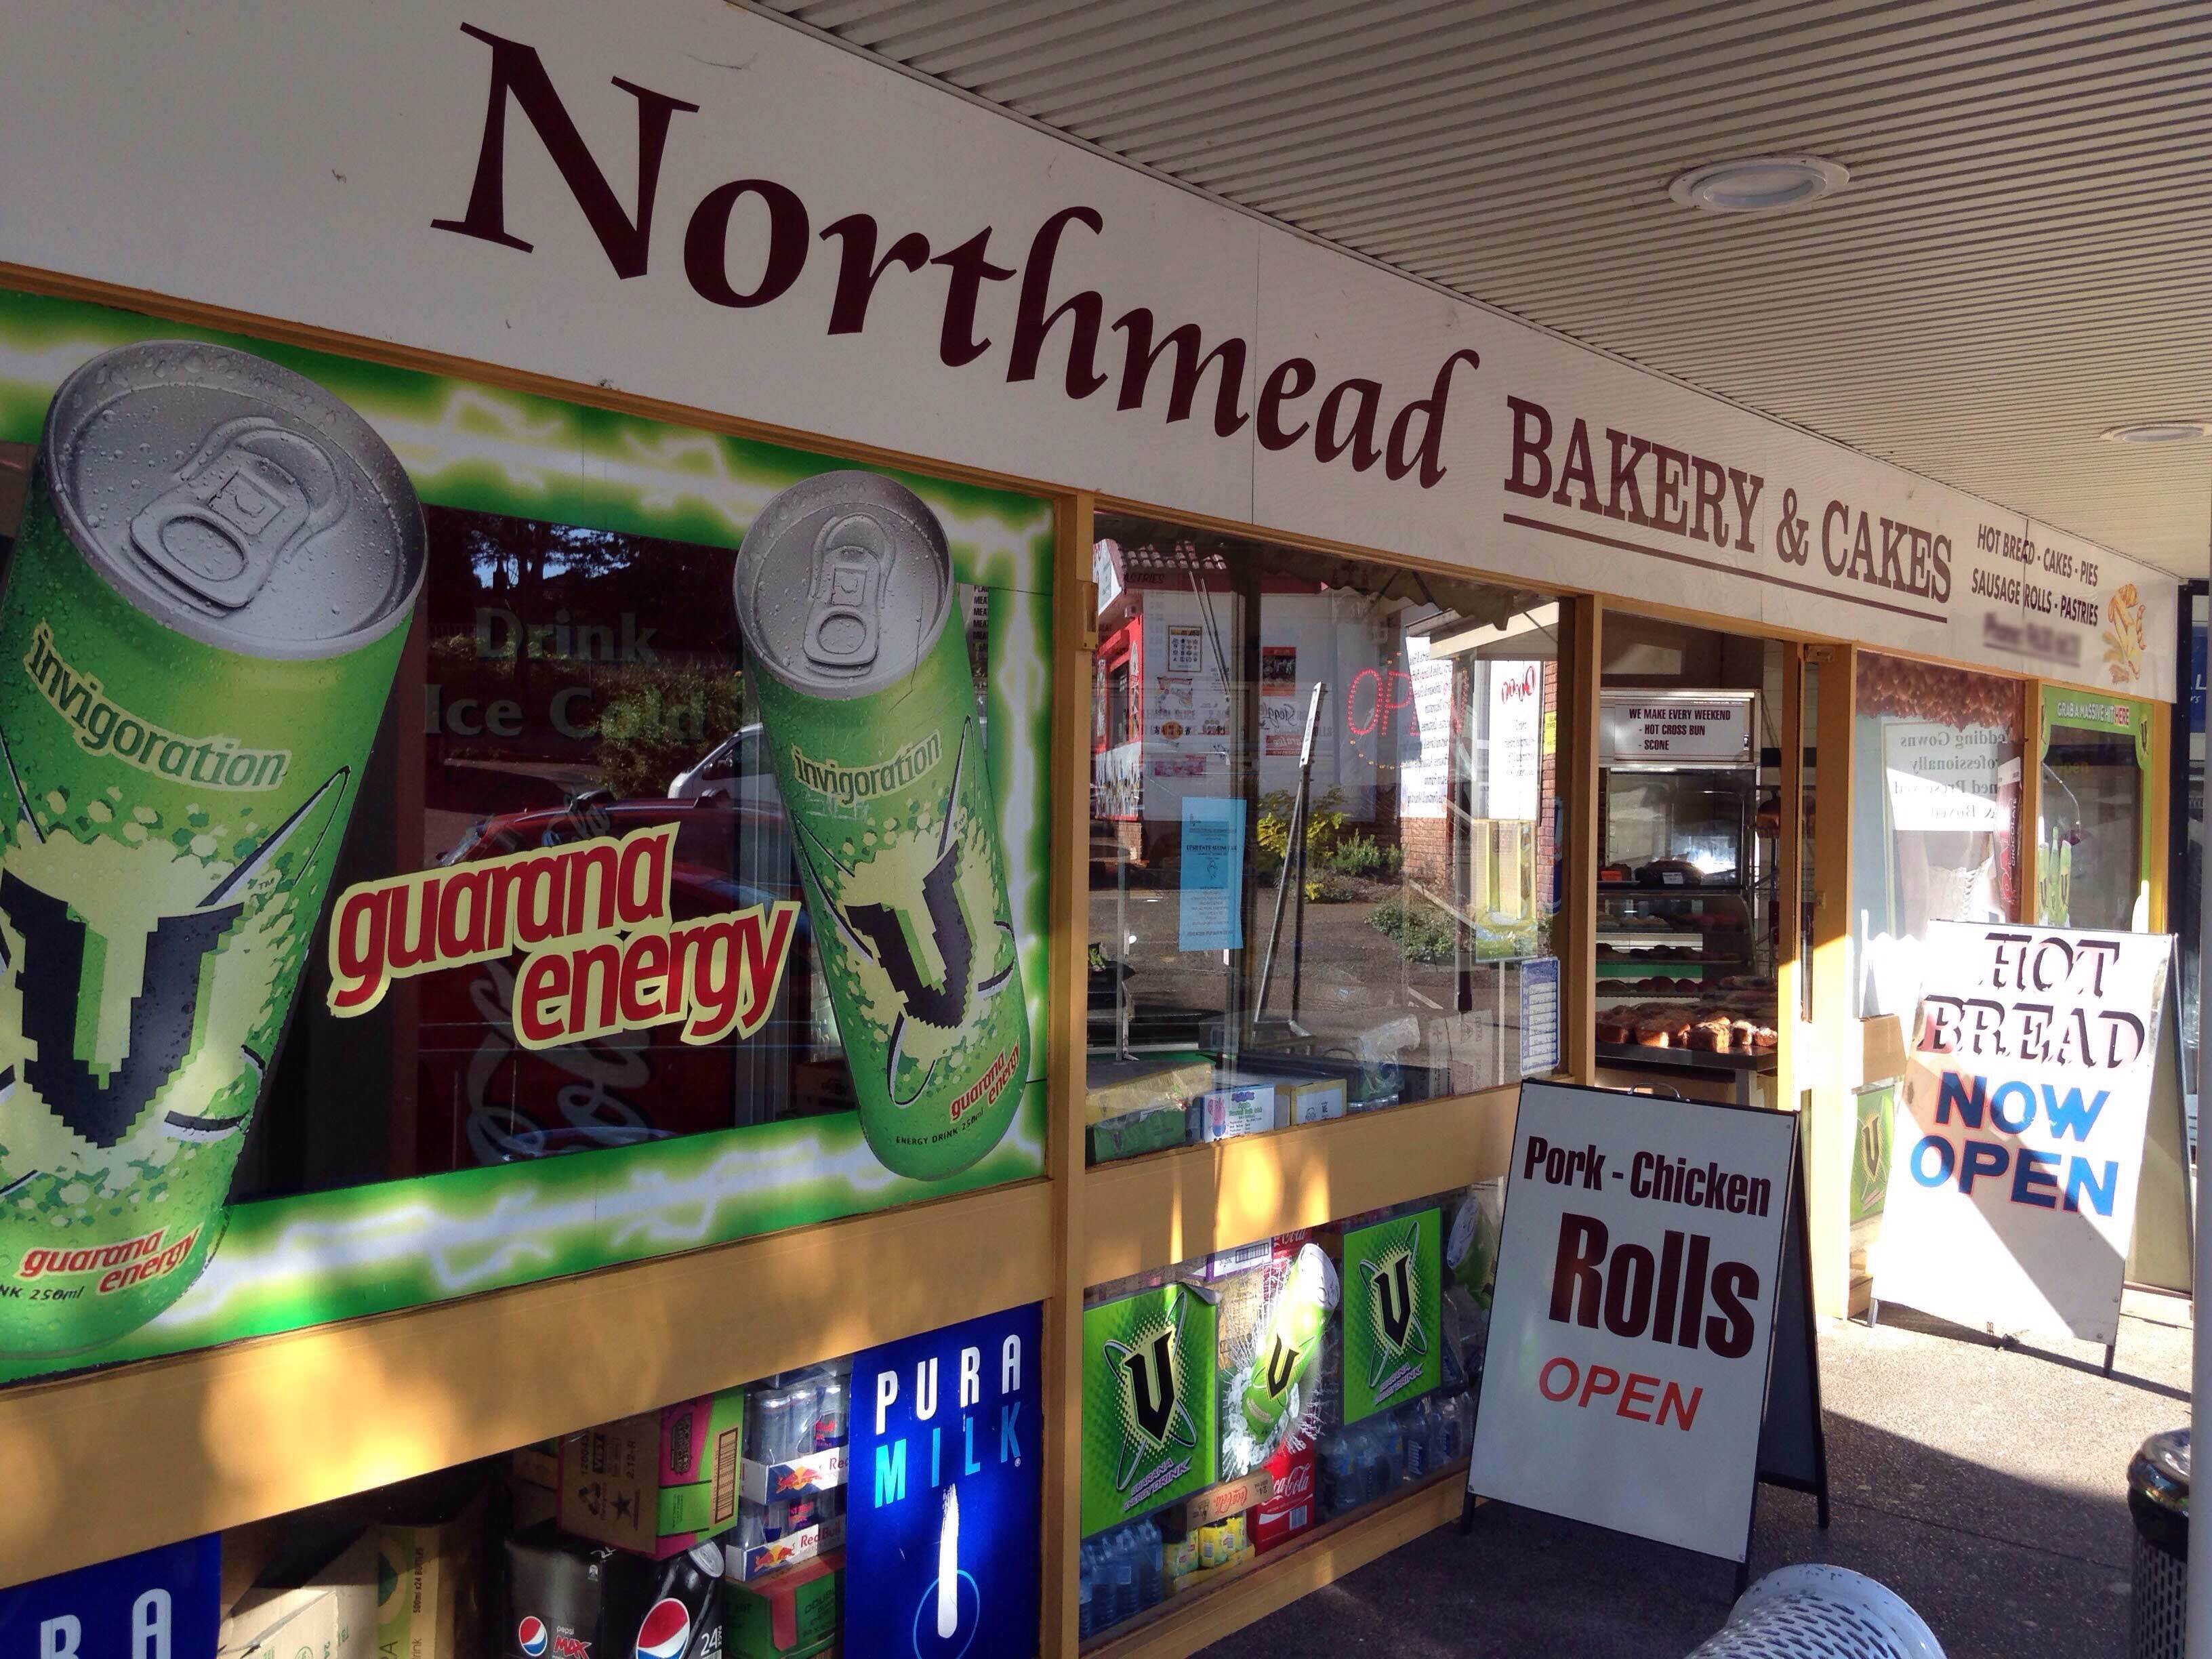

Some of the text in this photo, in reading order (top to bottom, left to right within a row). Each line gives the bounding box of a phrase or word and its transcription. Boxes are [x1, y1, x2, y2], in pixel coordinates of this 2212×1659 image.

[430, 22, 1480, 489] Northmead
[1504, 395, 1952, 604] BAKERY & CAKES
[1977, 523, 2001, 554] HOT
[2003, 533, 2034, 565] BREAD
[2043, 548, 2072, 579] CAKES
[2081, 560, 2098, 587] PIES
[1971, 568, 2021, 605] SAUSAGE
[2024, 583, 2051, 614] ROLLS
[2060, 595, 2098, 628] PASTRIES
[476, 607, 661, 662] Drink
[28, 629, 287, 787] invigoration
[425, 684, 706, 740] Ice Cold
[1347, 667, 1469, 737] OPN
[1629, 708, 1731, 720] WE MAKE EVERY WEEKEND
[1645, 724, 1659, 735] HOT
[1662, 724, 1687, 735] CROSS
[1689, 725, 1705, 735] BUN
[2057, 702, 2129, 726] GRAB A MASSIVE HIT HERE
[794, 734, 942, 801] invigoration
[1644, 740, 1669, 750] SCONE
[332, 831, 671, 1008] guarana
[845, 842, 975, 1029] V
[519, 907, 794, 1041] energy
[1978, 932, 2121, 999] HOT
[1916, 995, 2146, 1073] BREAD
[896, 1135, 928, 1146] ENERGY
[932, 1126, 958, 1144] DRINK
[1935, 1069, 2111, 1143] NOW
[1523, 1135, 1607, 1191] Pork
[1630, 1150, 1772, 1218] Chicken
[1909, 1132, 2119, 1217] OPEN
[20, 1229, 165, 1277] guarana
[1548, 1212, 1760, 1359] Rolls
[29, 1285, 85, 1301] 250ml
[1373, 1252, 1410, 1349] V
[874, 1333, 1021, 1435] PURA
[1123, 1328, 1176, 1442] V
[1265, 1332, 1300, 1399] V
[1538, 1355, 1704, 1432] OPEN
[873, 1400, 1022, 1509] MILK
[1152, 1457, 1193, 1492] DRINK
[800, 1520, 841, 1548] Red Bull
[553, 1634, 592, 1659] MAX
[556, 1626, 575, 1635] pepsi
[700, 1626, 718, 1656] 24
